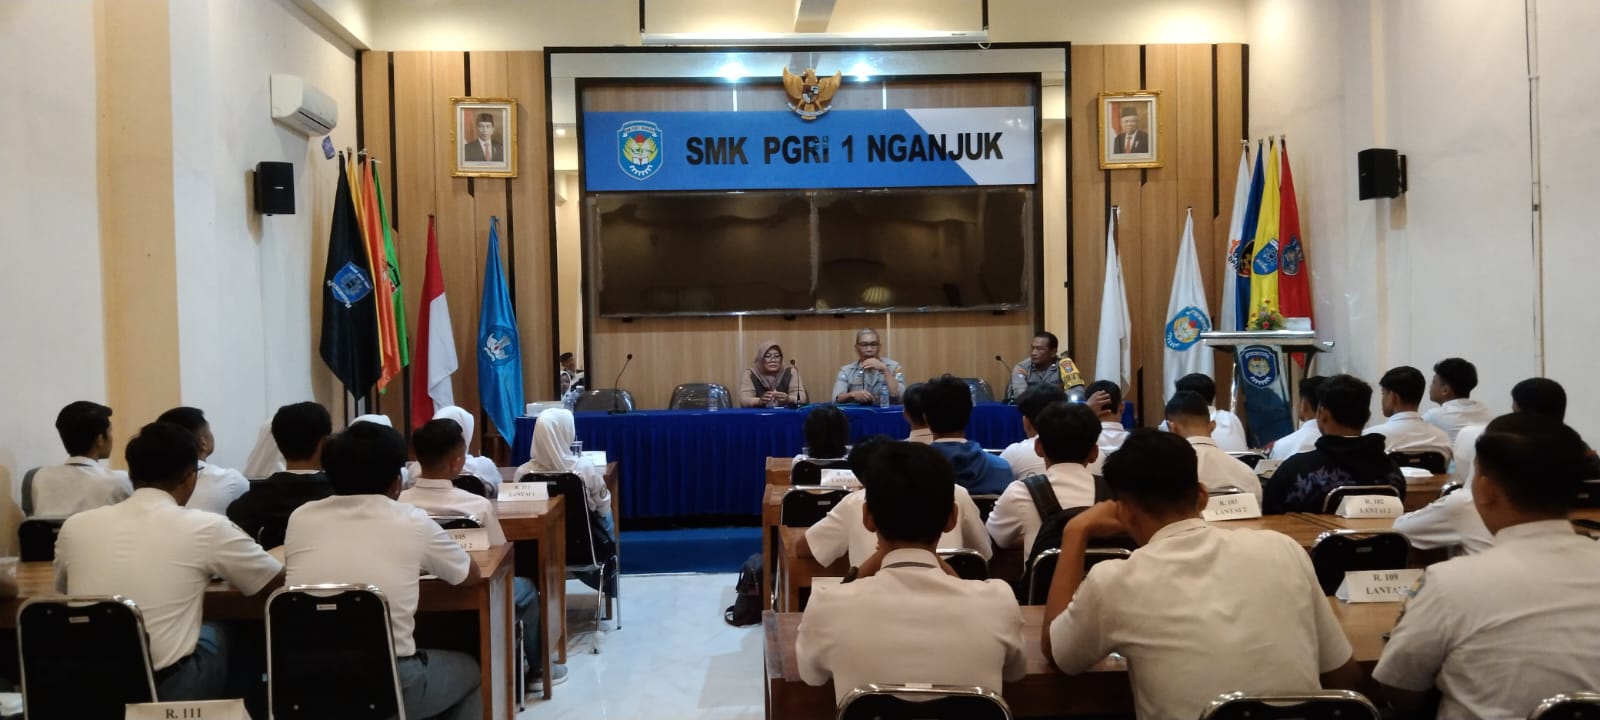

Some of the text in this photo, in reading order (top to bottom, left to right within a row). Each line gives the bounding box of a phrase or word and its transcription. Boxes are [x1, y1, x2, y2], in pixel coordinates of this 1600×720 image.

[686, 136, 748, 165] SMK
[841, 134, 853, 163] 1
[867, 132, 1003, 163] NGANJUK
[165, 707, 201, 719] R. 111
